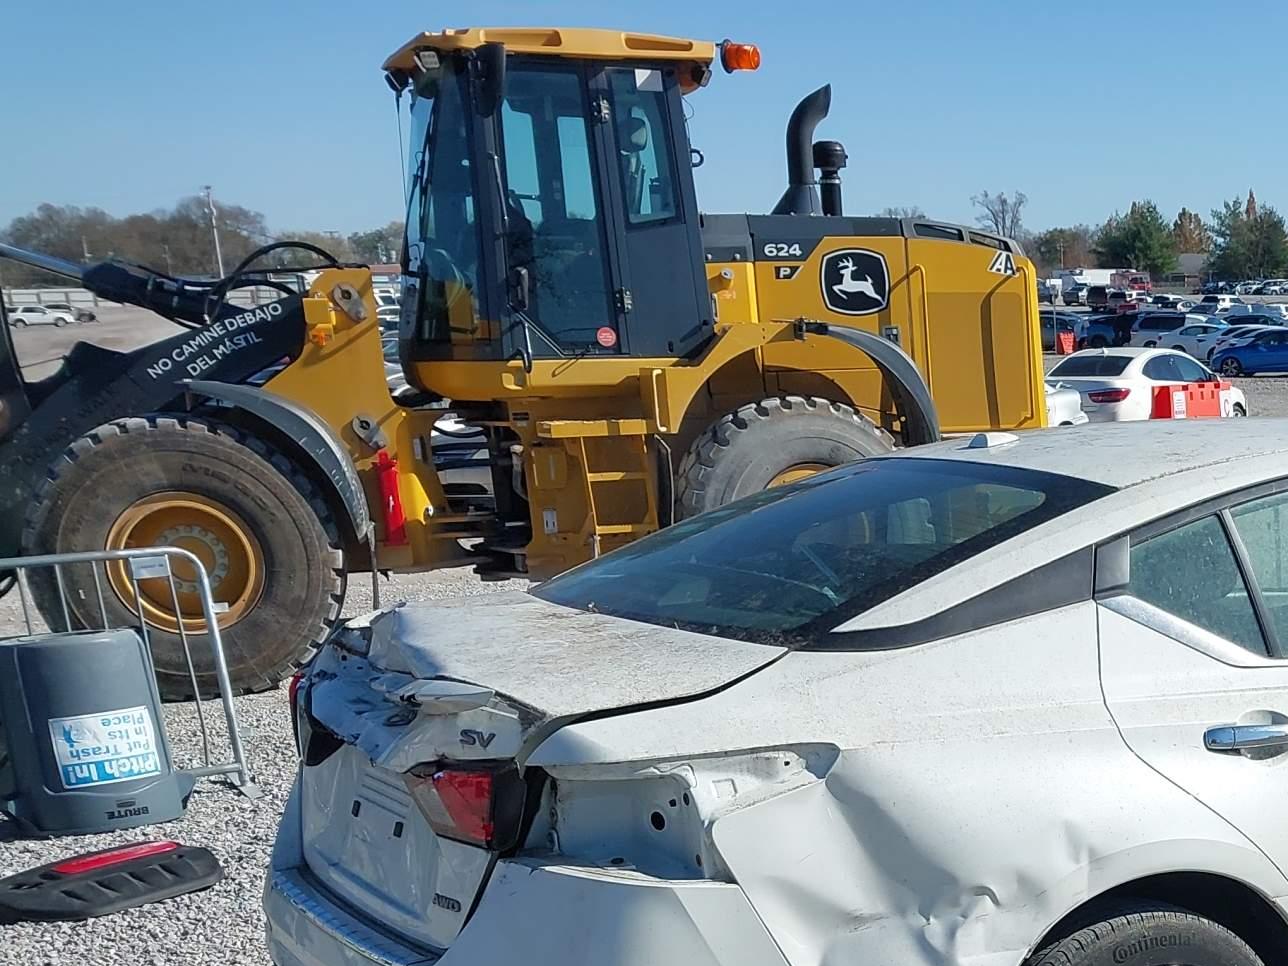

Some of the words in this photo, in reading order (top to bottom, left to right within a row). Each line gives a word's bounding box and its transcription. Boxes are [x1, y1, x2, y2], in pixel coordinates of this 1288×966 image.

[764, 243, 802, 257] 624
[779, 266, 792, 279] P
[146, 358, 172, 379] NO
[172, 322, 227, 362] CAMINE
[224, 303, 282, 332] DEBAJO
[186, 354, 217, 376] DEL
[100, 712, 144, 727] Place
[107, 729, 129, 743] Its
[134, 725, 148, 738] In
[459, 729, 496, 748] SV
[69, 745, 121, 760] Trash
[127, 738, 150, 752] Put
[66, 763, 99, 783] In!
[104, 753, 156, 778] Pitch
[105, 806, 149, 820] BRUTE
[432, 893, 461, 912] AWD
[1113, 932, 1196, 964] Continental
